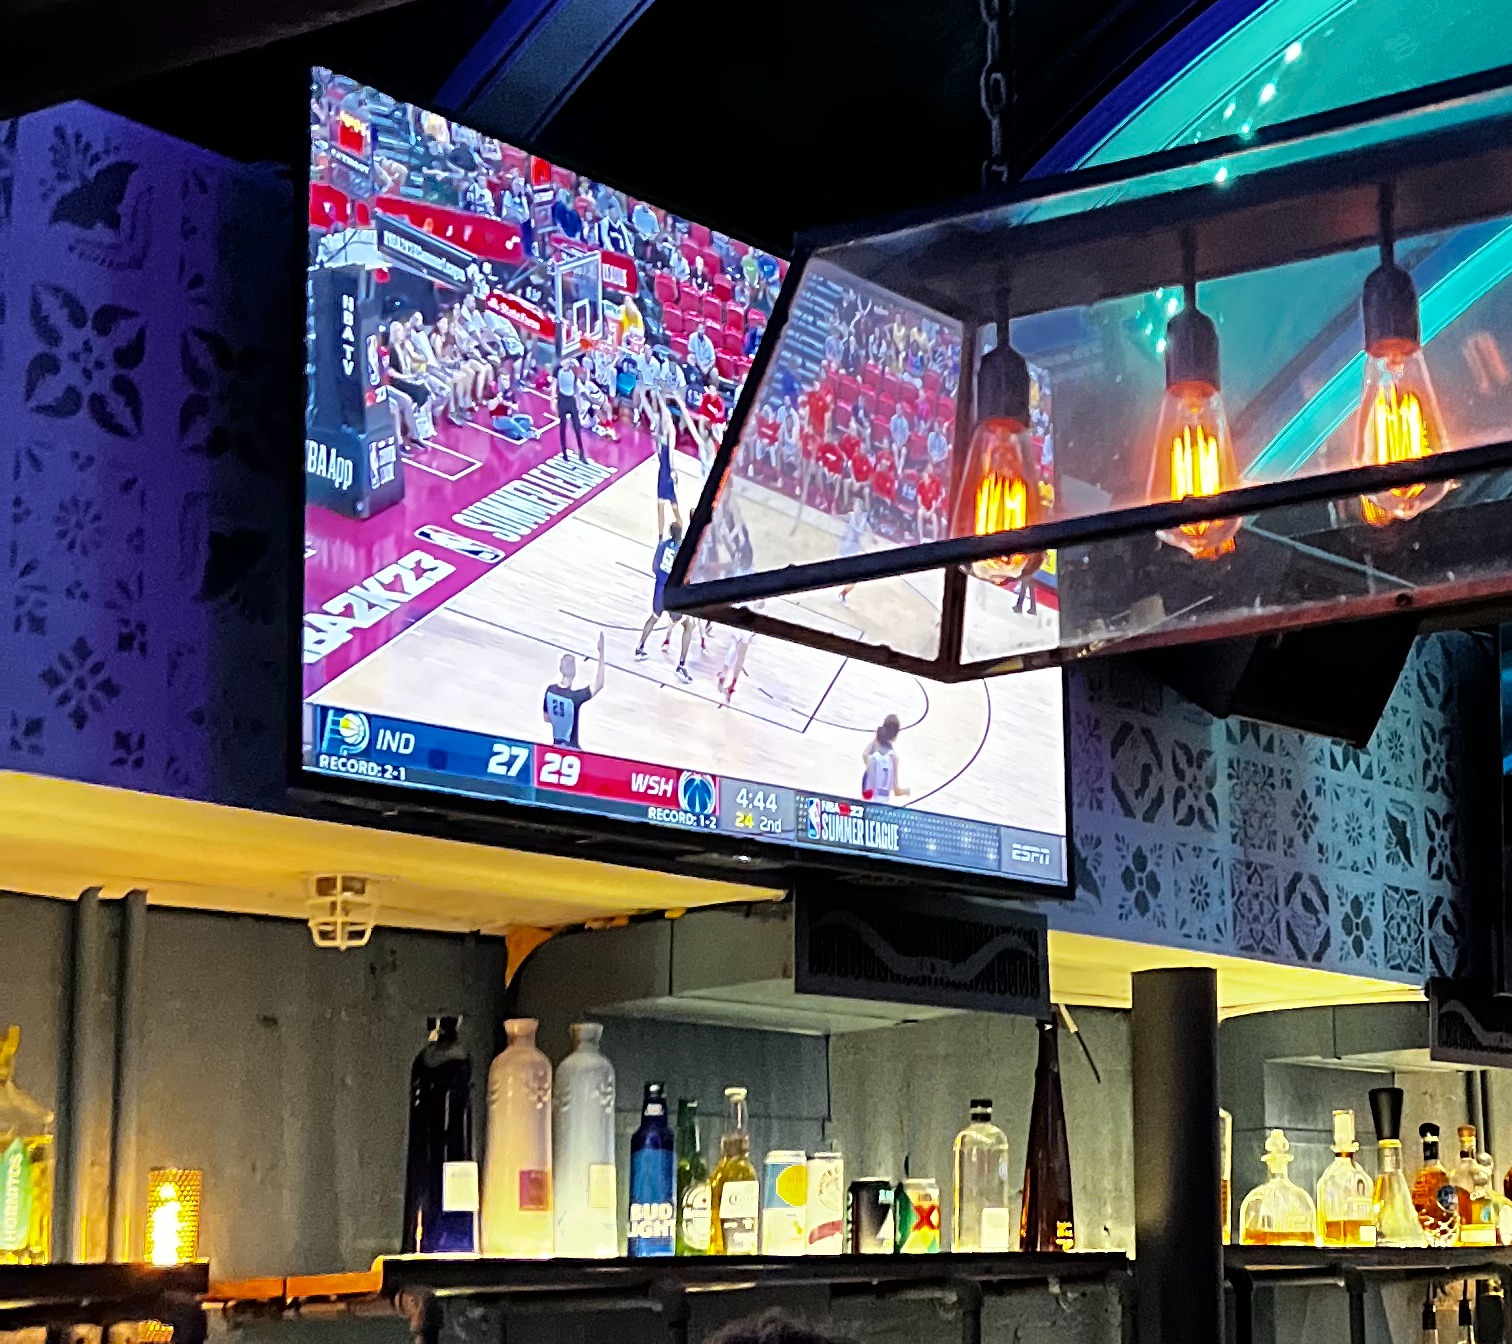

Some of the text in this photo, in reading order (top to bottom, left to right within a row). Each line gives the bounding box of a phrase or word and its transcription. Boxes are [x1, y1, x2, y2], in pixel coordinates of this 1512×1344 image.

[305, 440, 327, 477] BA
[375, 728, 416, 755] IND
[319, 754, 382, 778] RECORD:
[487, 743, 530, 777] 27
[539, 752, 581, 787] 29
[630, 773, 674, 798] WSH
[736, 787, 778, 813] 4:44
[648, 806, 698, 827] RECORD:
[735, 811, 782, 833] 24 2nd
[821, 813, 900, 851] SUMMER LEAGUE
[1011, 843, 1050, 865] ESPN
[630, 1202, 674, 1221] BUD
